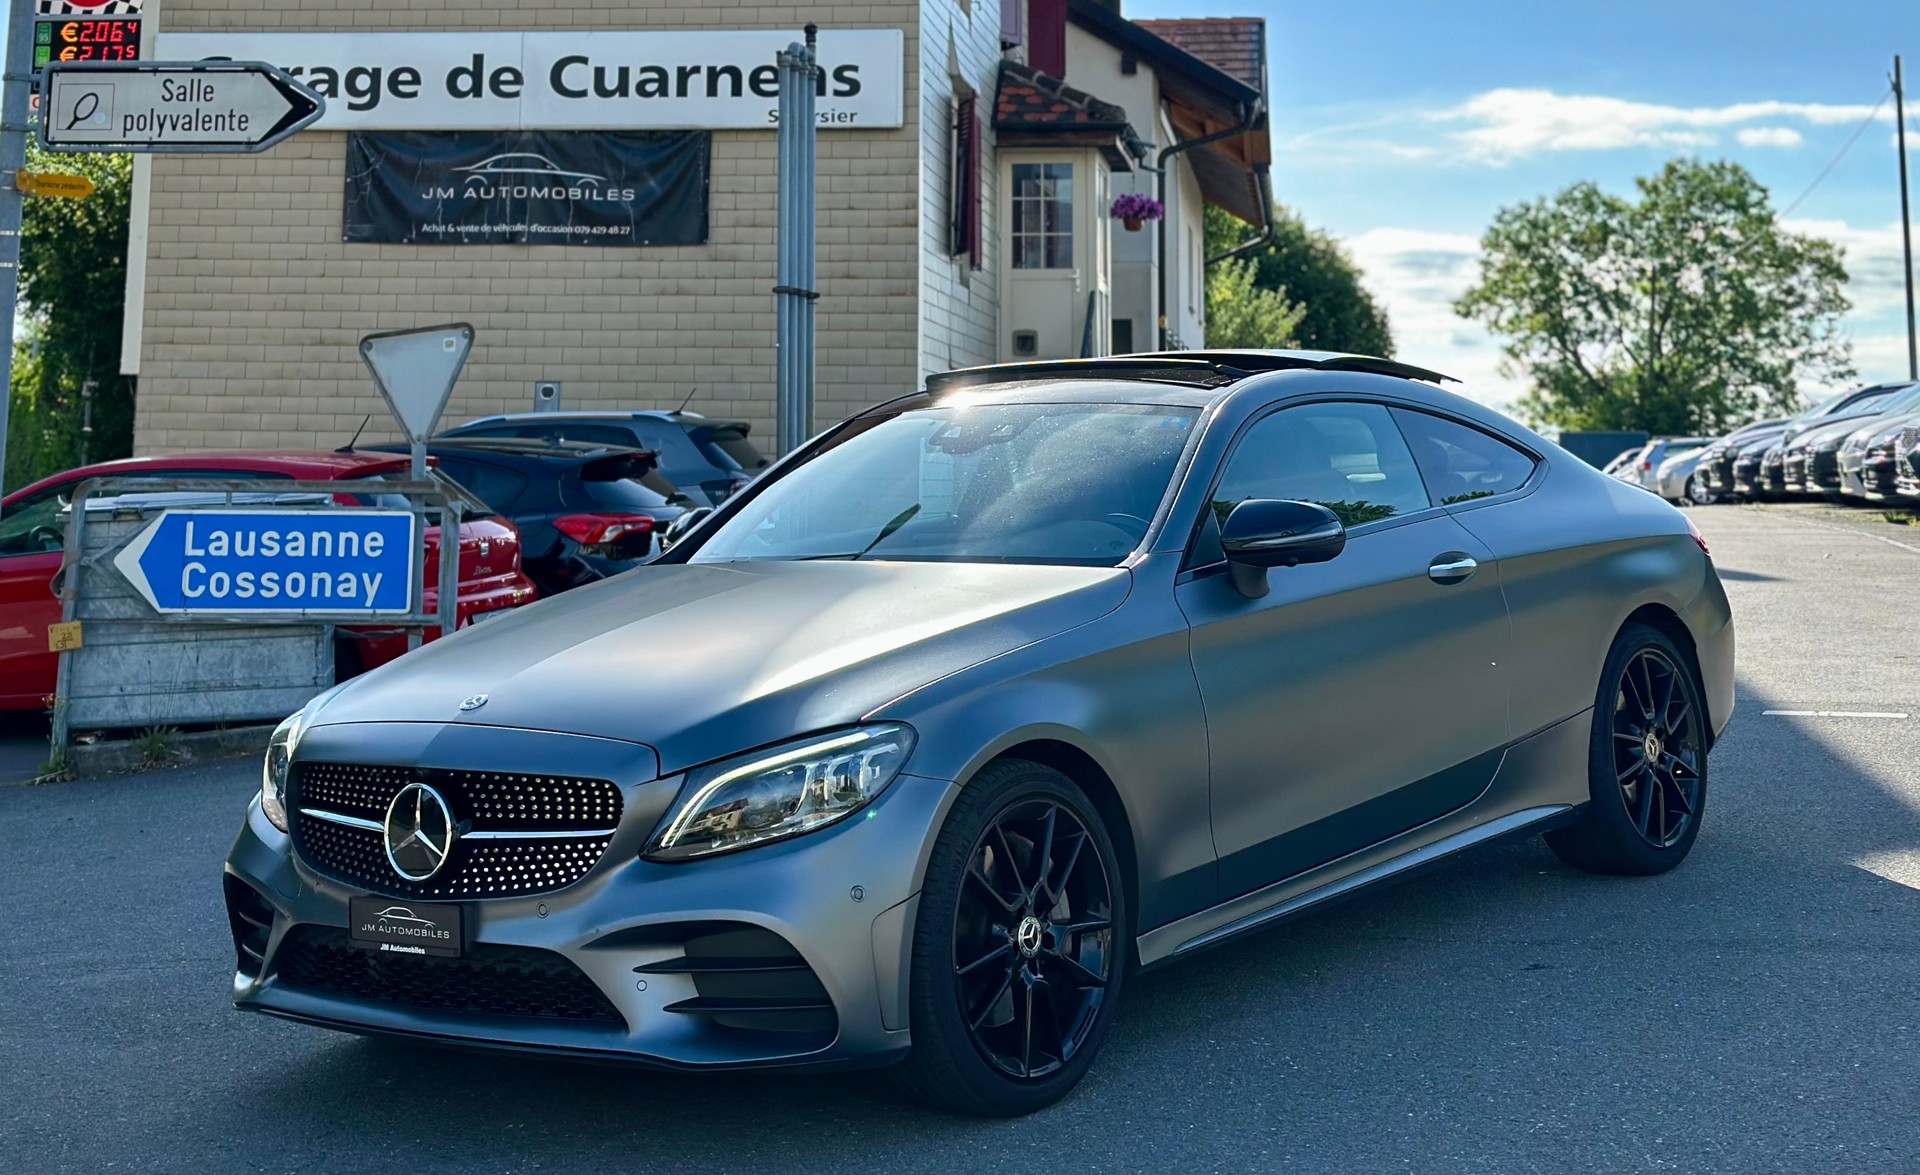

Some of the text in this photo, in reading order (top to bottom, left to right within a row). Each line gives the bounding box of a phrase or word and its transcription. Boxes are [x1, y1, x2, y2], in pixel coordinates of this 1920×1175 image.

[446, 53, 524, 99] de
[161, 78, 214, 102] Salle
[123, 108, 249, 138] polyvalente
[422, 186, 635, 201] JM AUTOMOBILES
[422, 223, 445, 232] Achat
[447, 223, 455, 232] &
[481, 223, 492, 232] de
[574, 225, 590, 234] 079
[591, 225, 607, 234] 429
[608, 225, 619, 234] 48
[620, 226, 630, 235] 27
[184, 521, 384, 557] Lausanne
[181, 562, 383, 607] Cossonay
[362, 924, 450, 939] JM AUTOMOBILES
[389, 944, 426, 954] Automobiles
